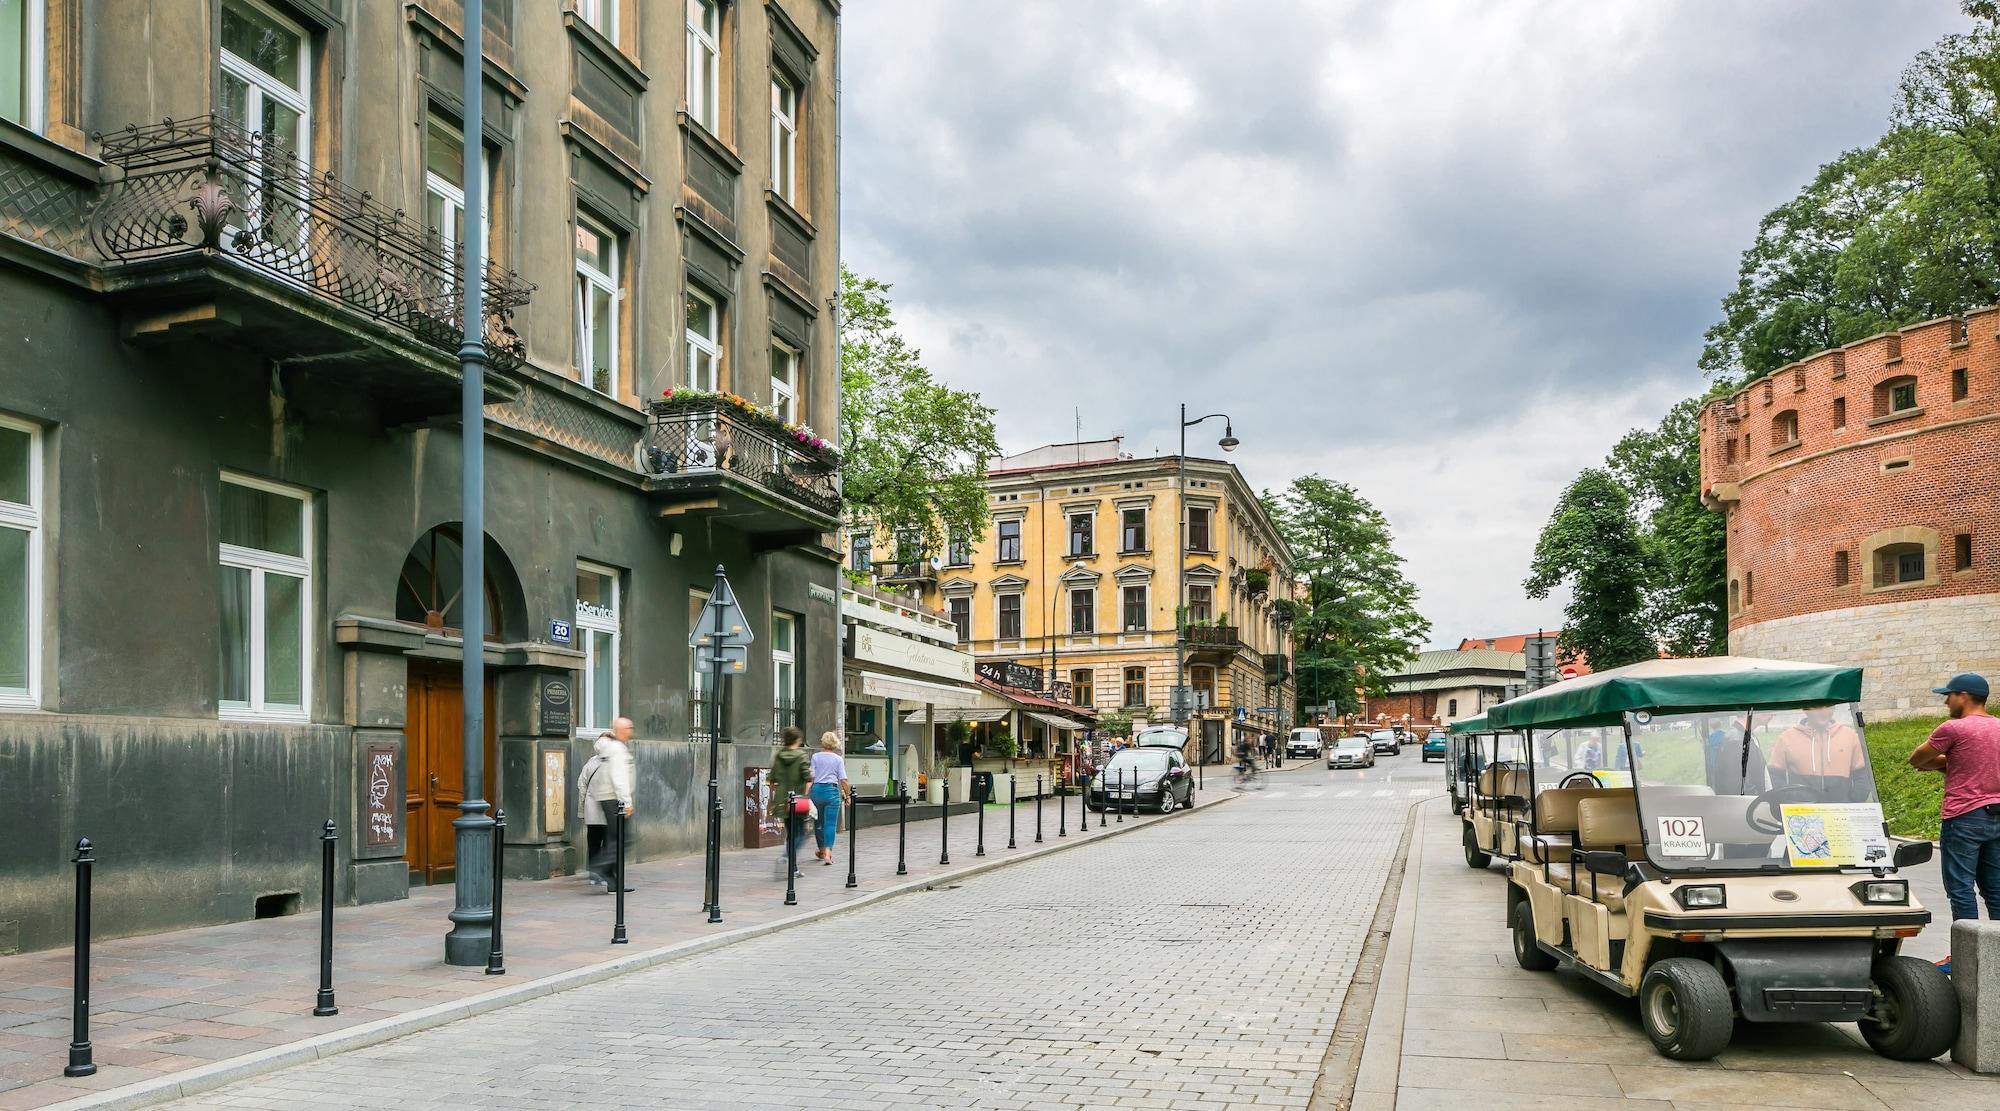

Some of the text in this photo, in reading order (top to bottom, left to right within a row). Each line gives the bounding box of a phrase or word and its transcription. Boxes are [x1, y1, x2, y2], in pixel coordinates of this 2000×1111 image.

[576, 599, 613, 618] bService
[555, 625, 568, 636] 20
[981, 665, 993, 677] 24
[994, 670, 1001, 681] h
[1662, 819, 1701, 837] 102
